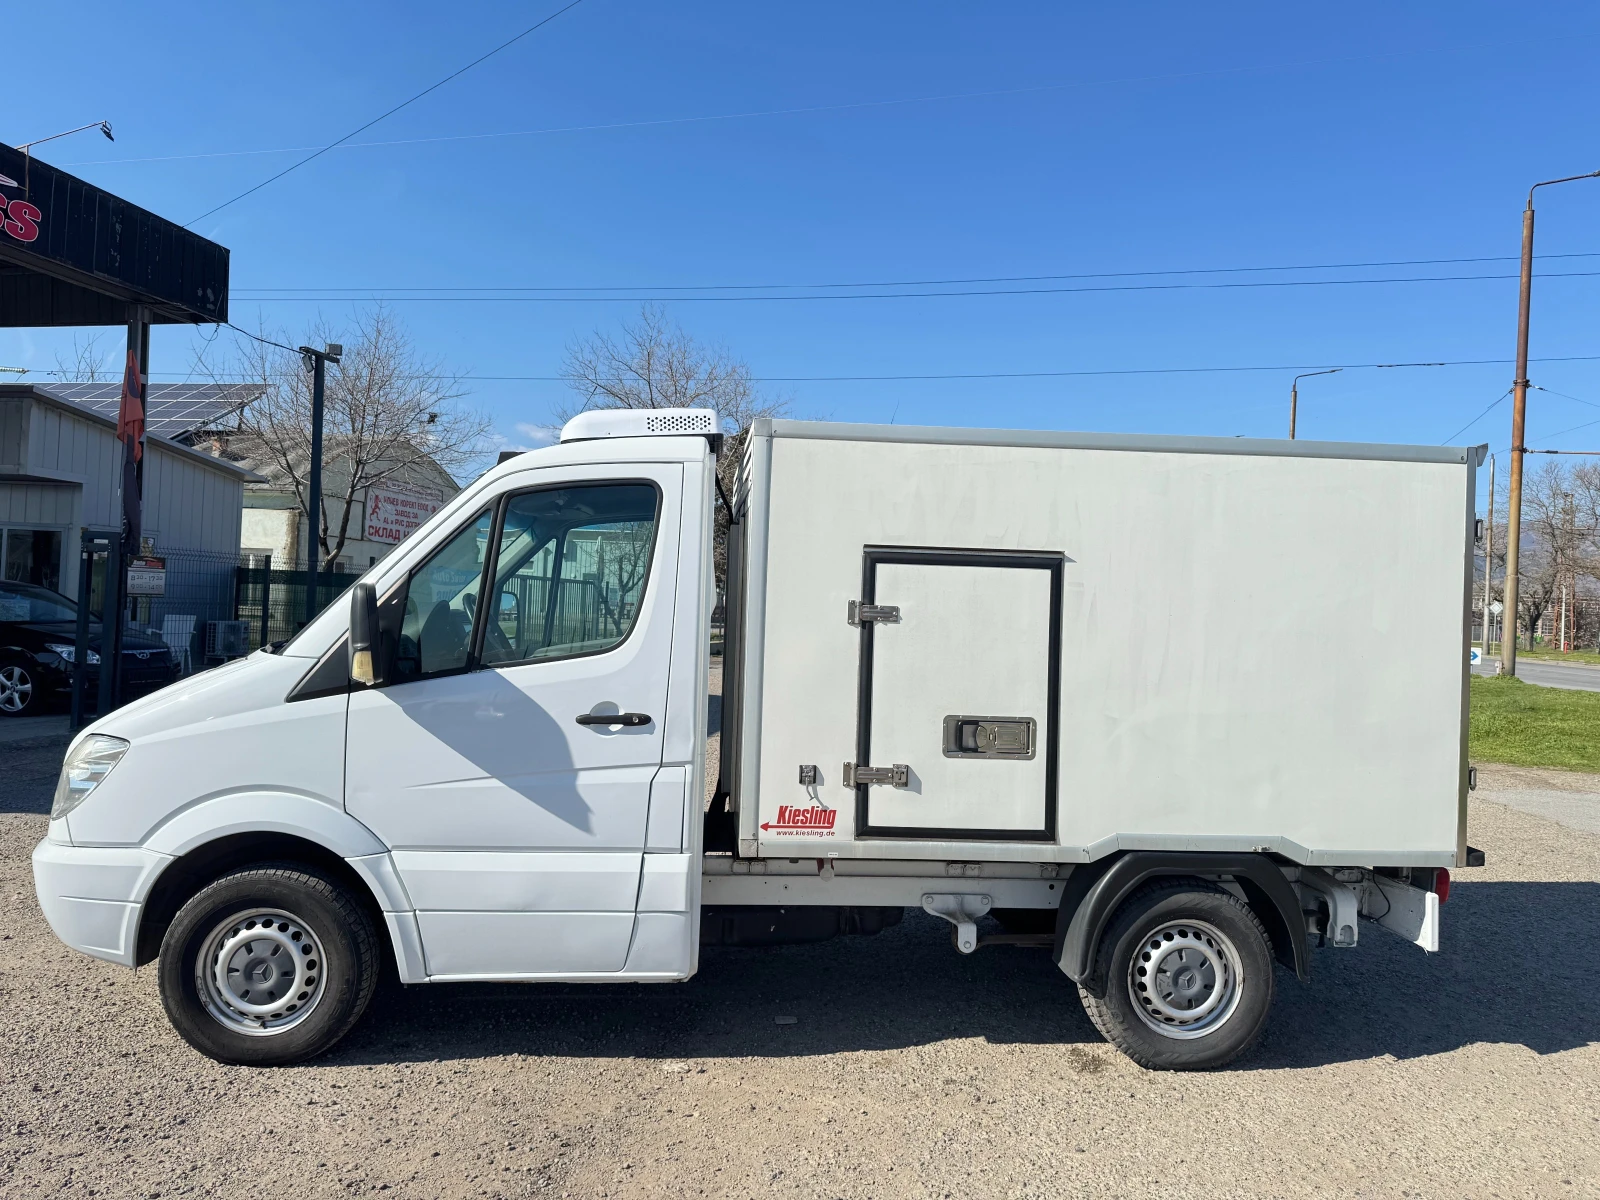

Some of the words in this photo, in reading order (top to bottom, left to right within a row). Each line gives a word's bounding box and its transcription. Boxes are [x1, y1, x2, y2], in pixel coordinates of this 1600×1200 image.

[394, 509, 410, 519] ЗАВОД
[411, 512, 419, 520] ЗА
[368, 525, 401, 542] СКЛАД
[776, 805, 837, 828] Kiesling
